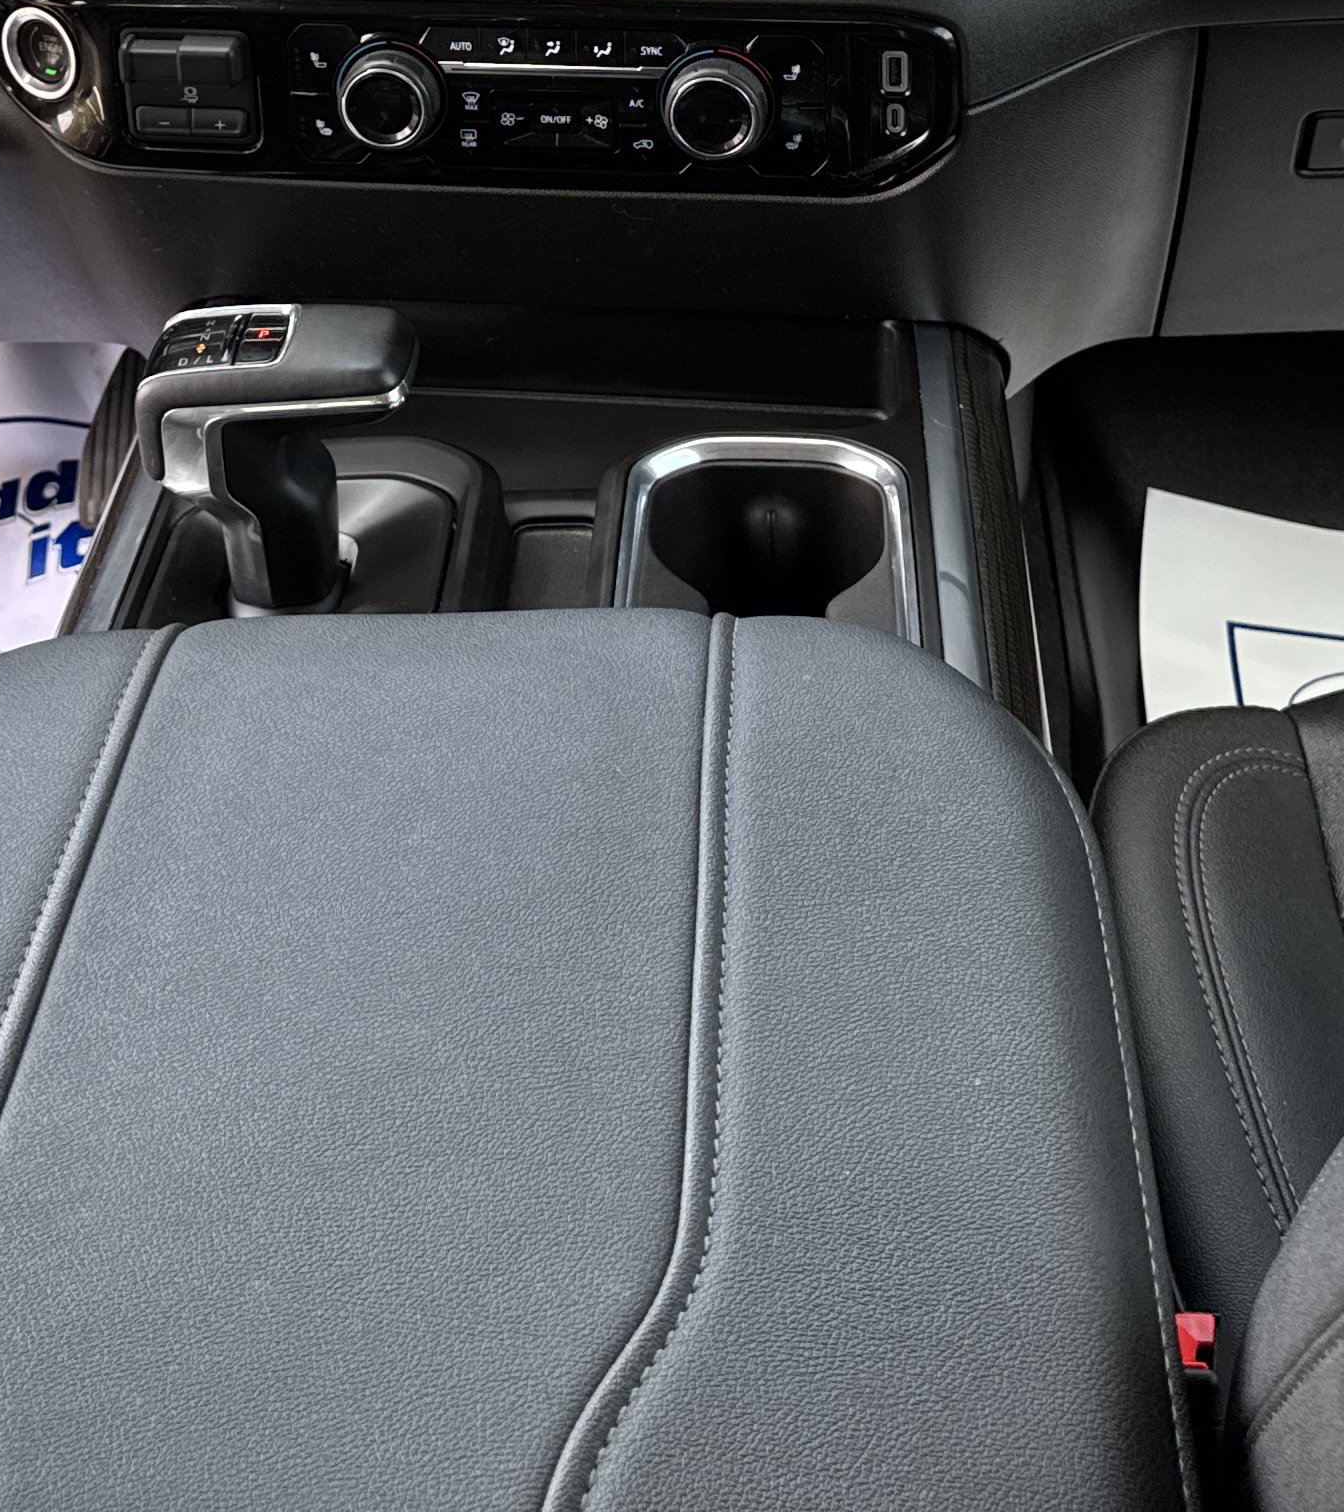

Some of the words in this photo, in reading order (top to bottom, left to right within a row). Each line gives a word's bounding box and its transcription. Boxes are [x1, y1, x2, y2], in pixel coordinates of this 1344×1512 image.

[449, 41, 472, 52] AUTO
[640, 46, 663, 56] SYNC
[629, 99, 645, 108] A/C
[540, 115, 572, 124] ON/OFF
[258, 329, 271, 339] P
[28, 521, 94, 582] it
